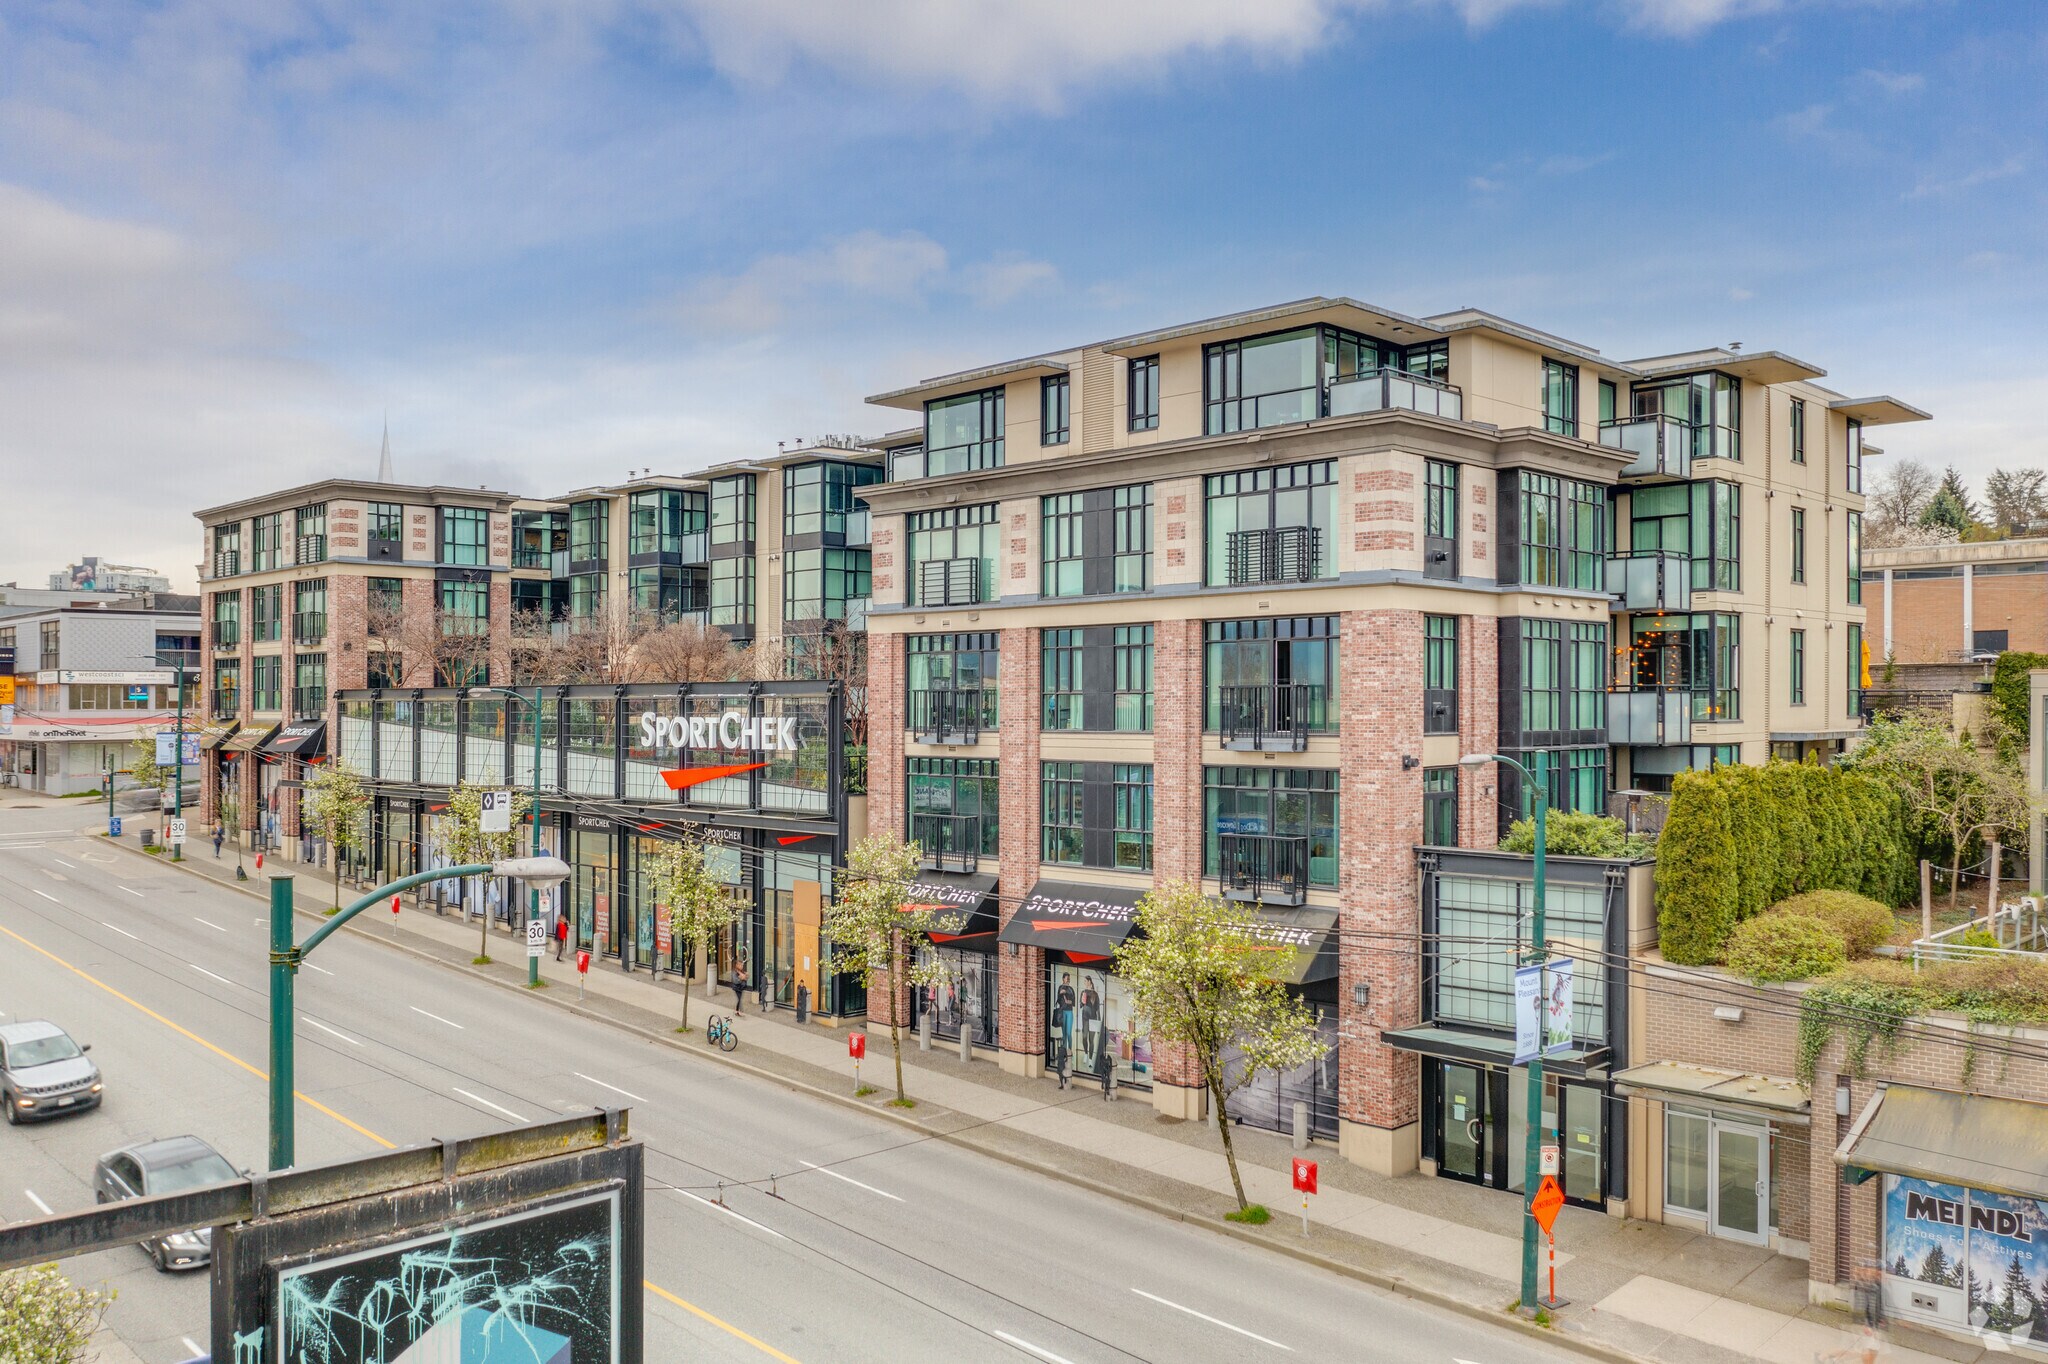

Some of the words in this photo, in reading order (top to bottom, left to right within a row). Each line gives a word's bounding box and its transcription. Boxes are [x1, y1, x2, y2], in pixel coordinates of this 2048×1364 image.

[281, 727, 317, 736] SPORTCHEK
[641, 711, 798, 750] SPORTCHEK
[389, 800, 410, 808] SPORTCHEK
[172, 822, 185, 831] 30
[578, 815, 610, 828] SPORTCHEK
[703, 826, 742, 841] SPORTCHEK
[1026, 894, 1137, 922] SPORTCHEK
[529, 926, 545, 939] 30
[1520, 978, 1538, 987] Mount
[1906, 1190, 2032, 1243] MEINDL
[1904, 1226, 1943, 1242] Shoes
[1949, 1234, 1976, 1248] For
[1982, 1241, 2033, 1260] Actives
